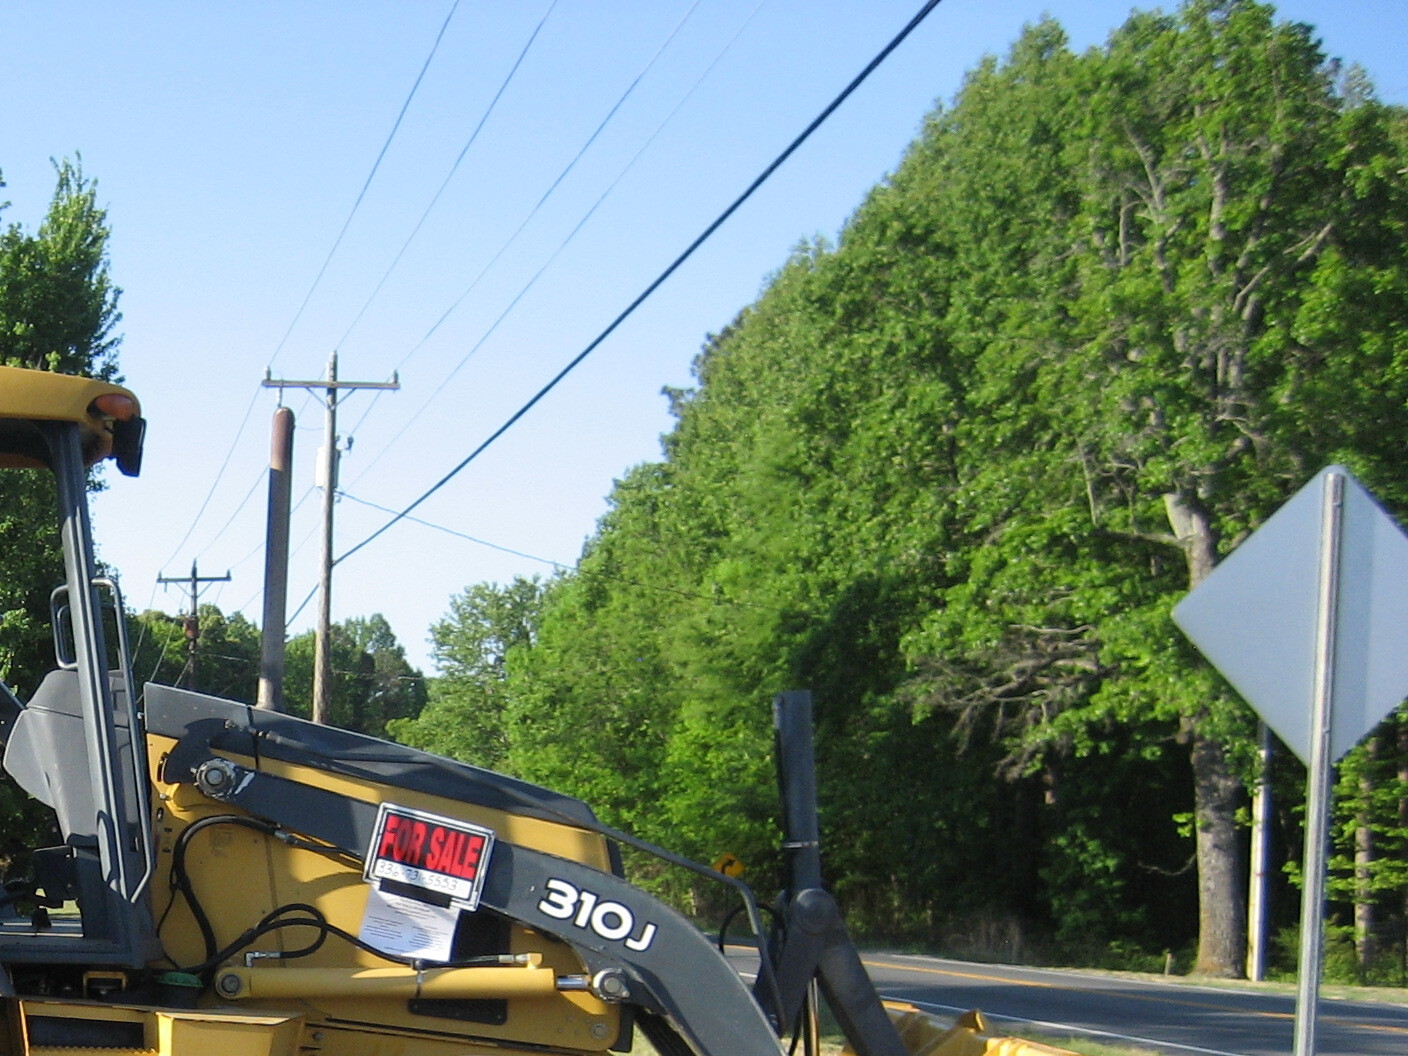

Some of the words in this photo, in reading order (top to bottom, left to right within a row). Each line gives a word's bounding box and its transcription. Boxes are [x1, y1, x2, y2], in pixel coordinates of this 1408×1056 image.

[378, 814, 427, 865] FOR
[425, 826, 485, 880] SALE
[538, 878, 657, 952] 310J
